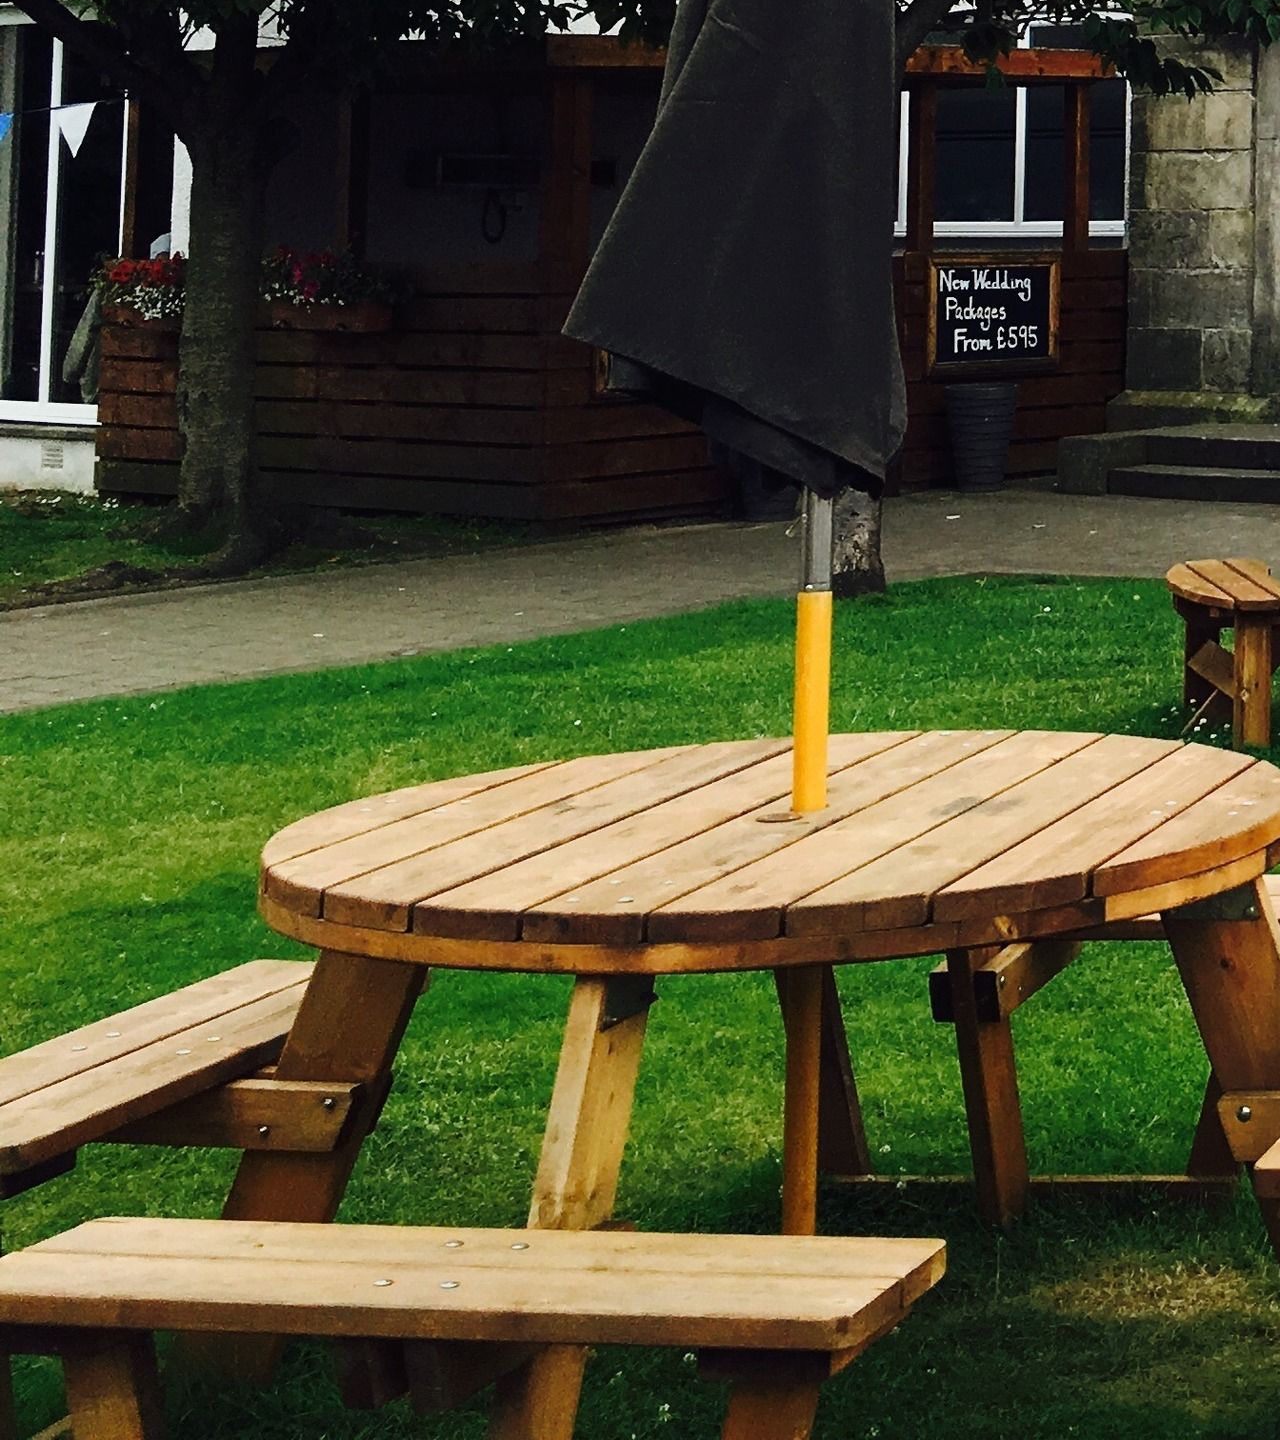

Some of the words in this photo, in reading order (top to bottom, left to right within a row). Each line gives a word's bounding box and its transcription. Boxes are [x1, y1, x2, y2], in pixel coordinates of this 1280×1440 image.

[940, 269, 970, 292] New
[971, 269, 1031, 301] Wedding
[946, 296, 1006, 331] Packages
[954, 328, 993, 353] From
[997, 326, 1038, 350] £595
